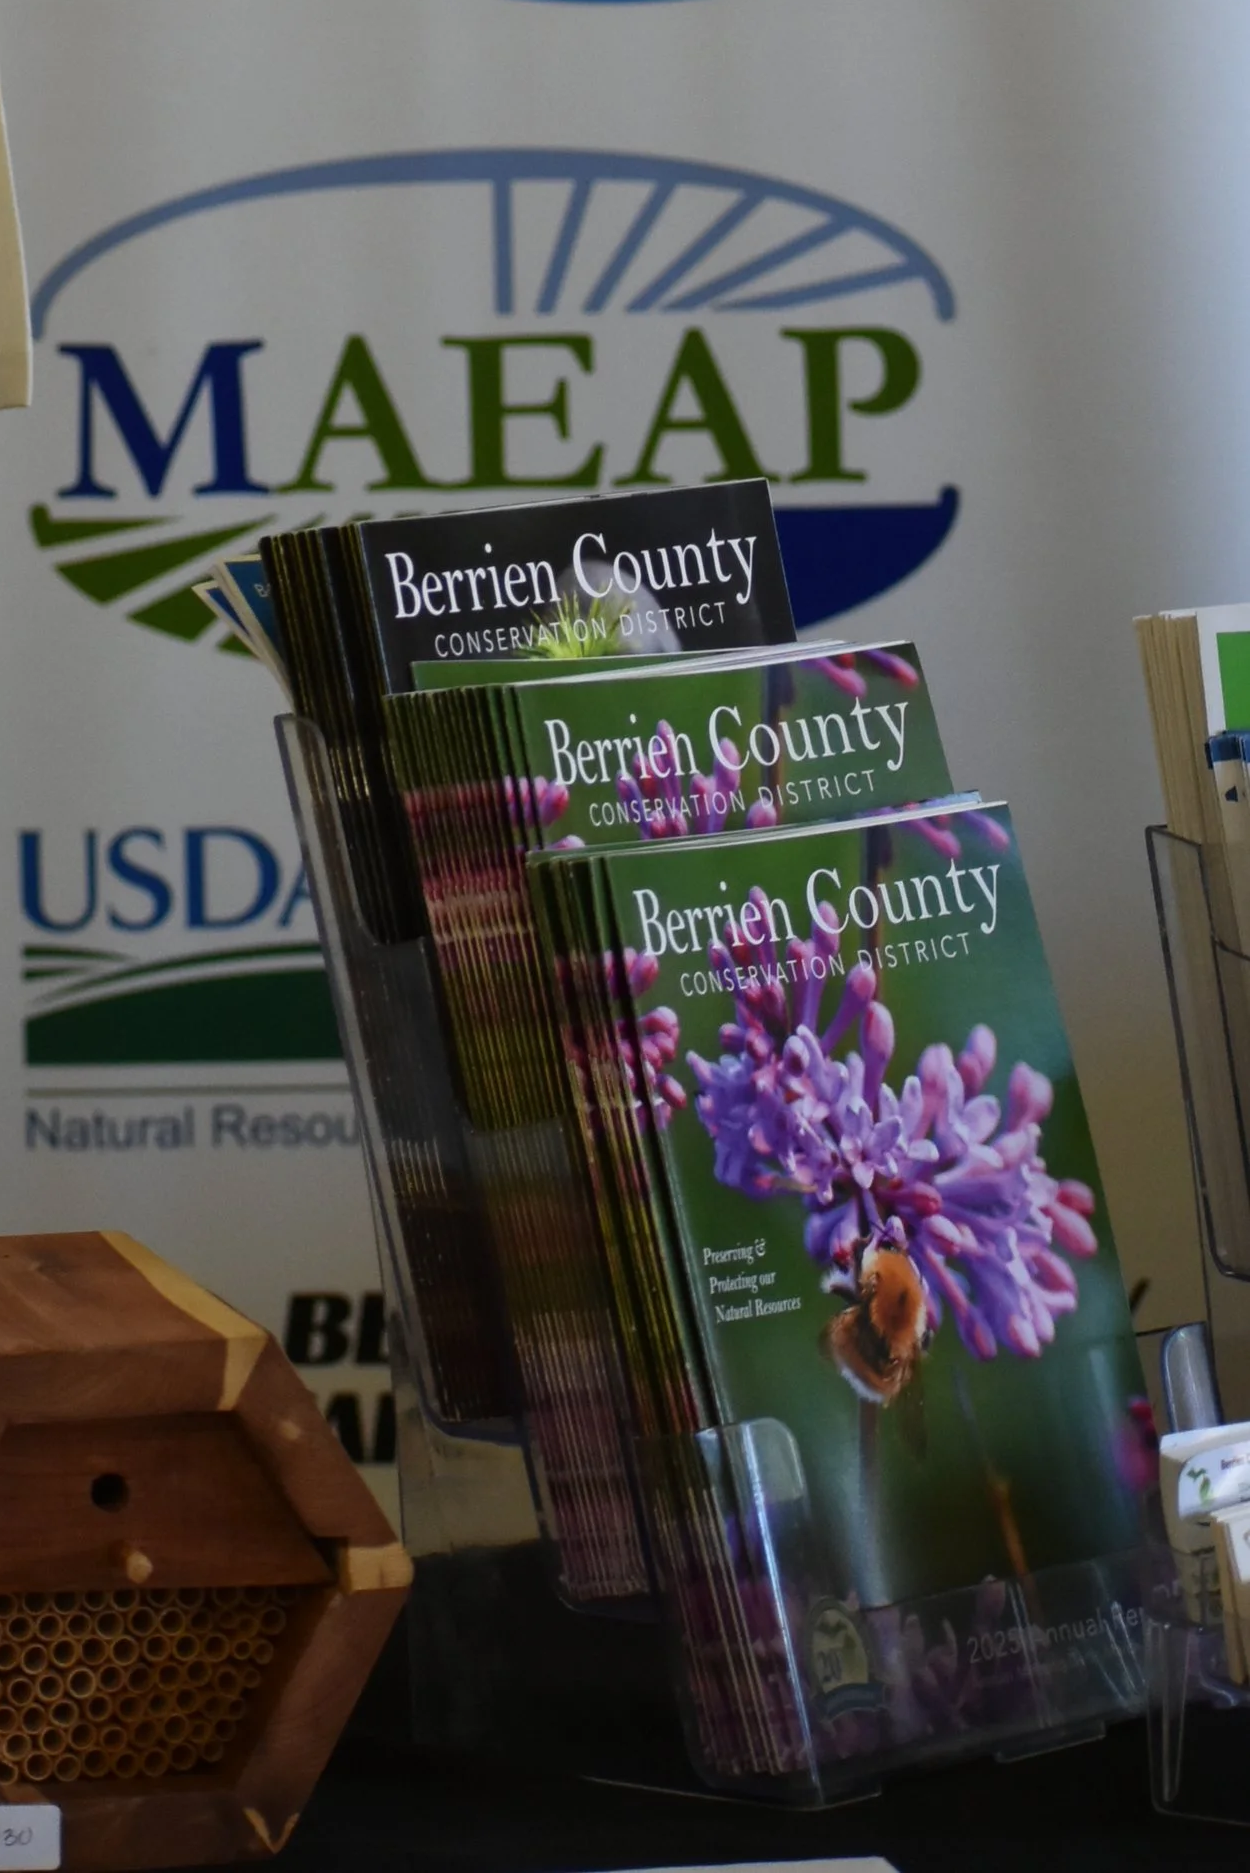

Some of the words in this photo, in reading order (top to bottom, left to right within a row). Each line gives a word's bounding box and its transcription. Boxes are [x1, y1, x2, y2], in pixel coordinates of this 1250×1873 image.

[58, 326, 923, 498] MAEAP
[385, 542, 562, 619] Berrien
[572, 527, 758, 605] County
[434, 616, 607, 659] CONSERVATION
[619, 601, 727, 637] DISTRICT
[544, 713, 701, 787] Berrien
[708, 696, 909, 772] County
[588, 790, 745, 827] CONSERVATION
[758, 769, 876, 808] DISTRICT
[632, 880, 798, 958] Berrien
[805, 857, 1001, 934] County
[679, 953, 846, 998] CONSERVATION
[857, 932, 972, 972] DISTRICT
[24, 1104, 196, 1152] Natural
[210, 1102, 361, 1151] Resou
[702, 1242, 754, 1266] Preserving
[754, 1237, 767, 1257] &
[708, 1271, 759, 1295] Protecting
[758, 1271, 777, 1287] our
[714, 1299, 753, 1324] Natural
[754, 1296, 802, 1318] Resources
